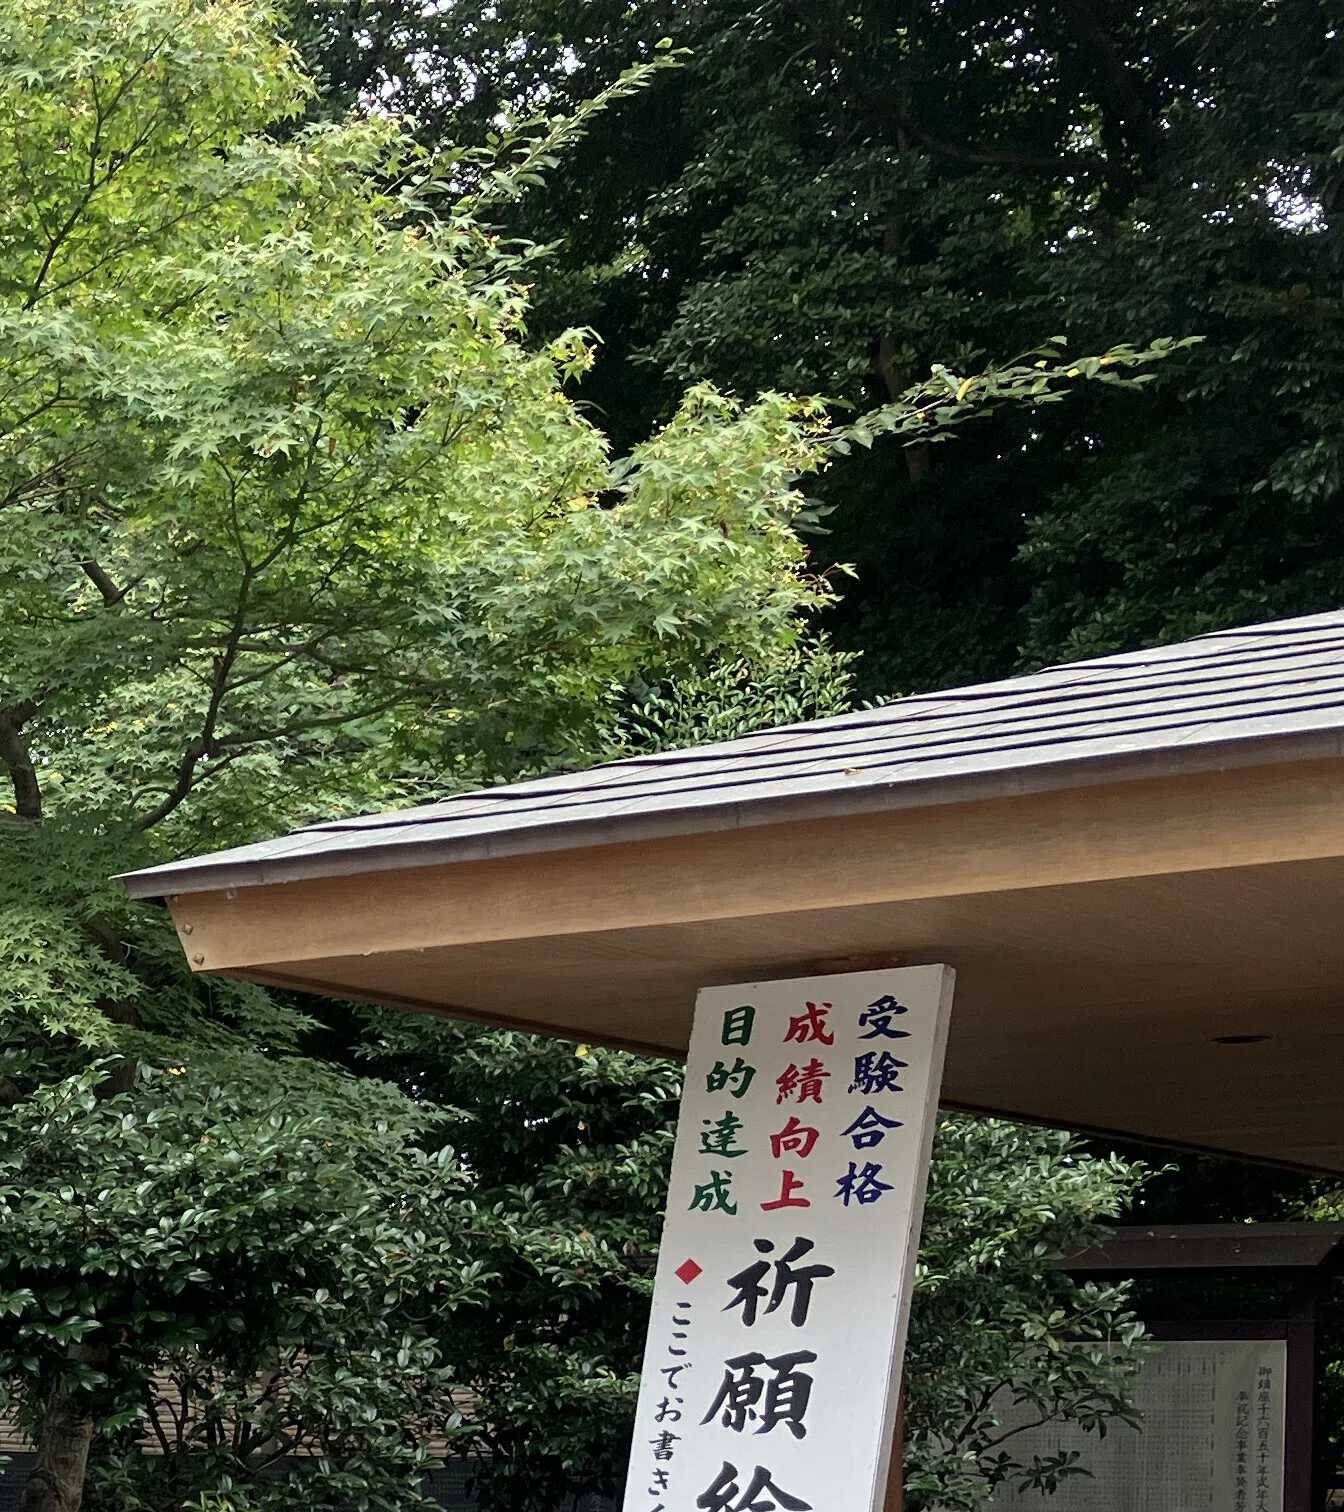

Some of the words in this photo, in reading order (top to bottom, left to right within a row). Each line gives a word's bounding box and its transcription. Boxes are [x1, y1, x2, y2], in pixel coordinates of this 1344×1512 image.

[688, 1004, 757, 1216] 目的達成
[760, 1000, 835, 1214] 成績向上
[834, 993, 913, 1208] 受験合格
